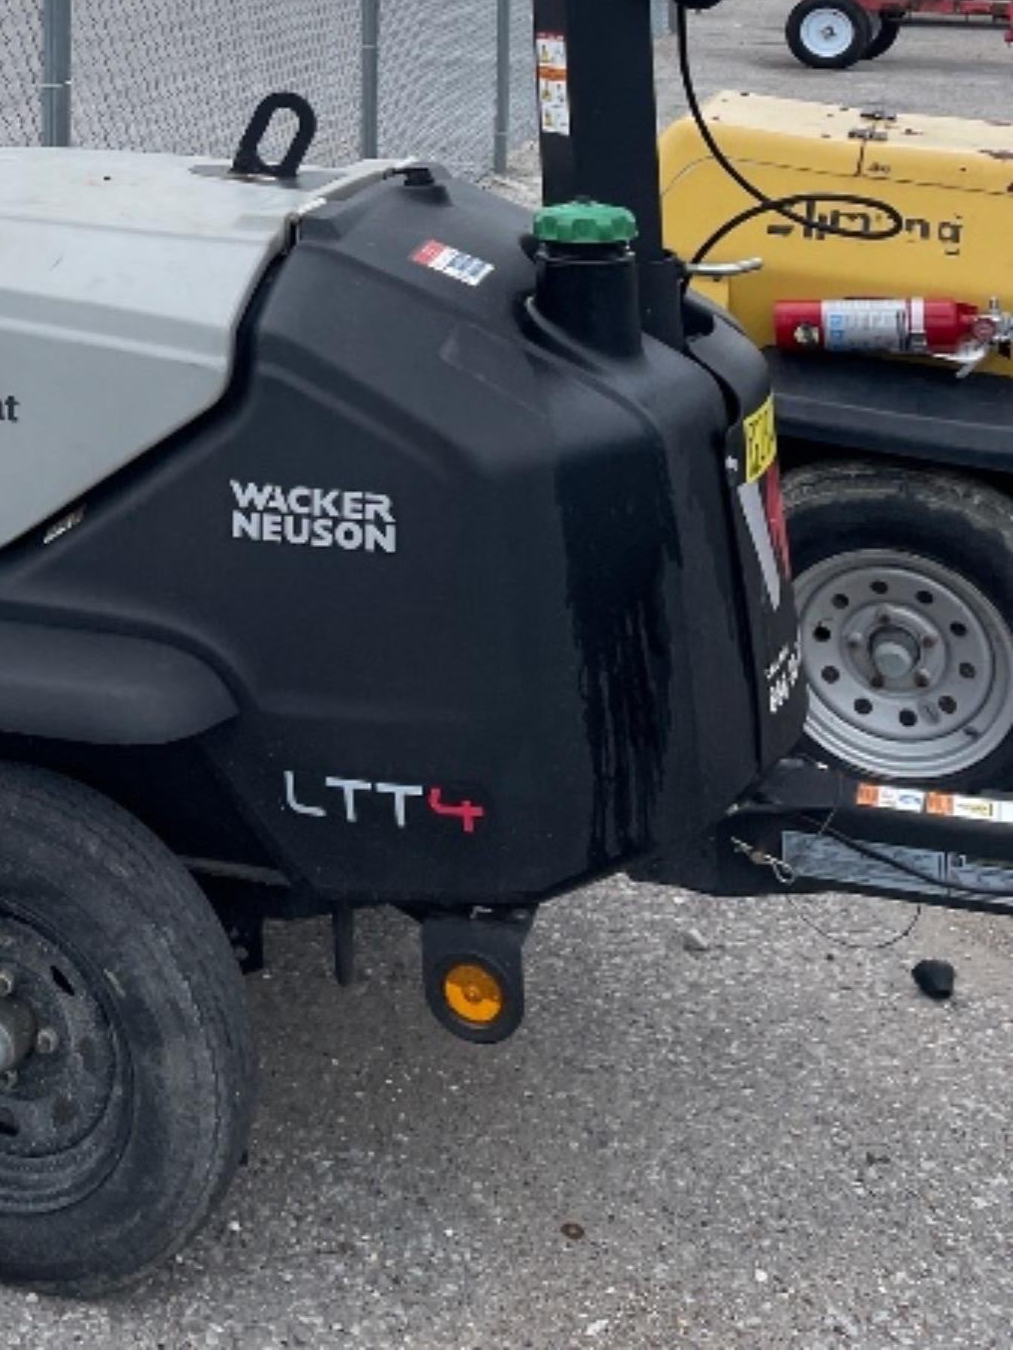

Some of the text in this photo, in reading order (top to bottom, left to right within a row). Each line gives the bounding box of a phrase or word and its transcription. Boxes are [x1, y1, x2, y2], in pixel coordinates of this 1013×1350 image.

[229, 479, 396, 522] WACKER
[231, 511, 397, 553] NEUSON
[283, 769, 484, 833] LTT4
